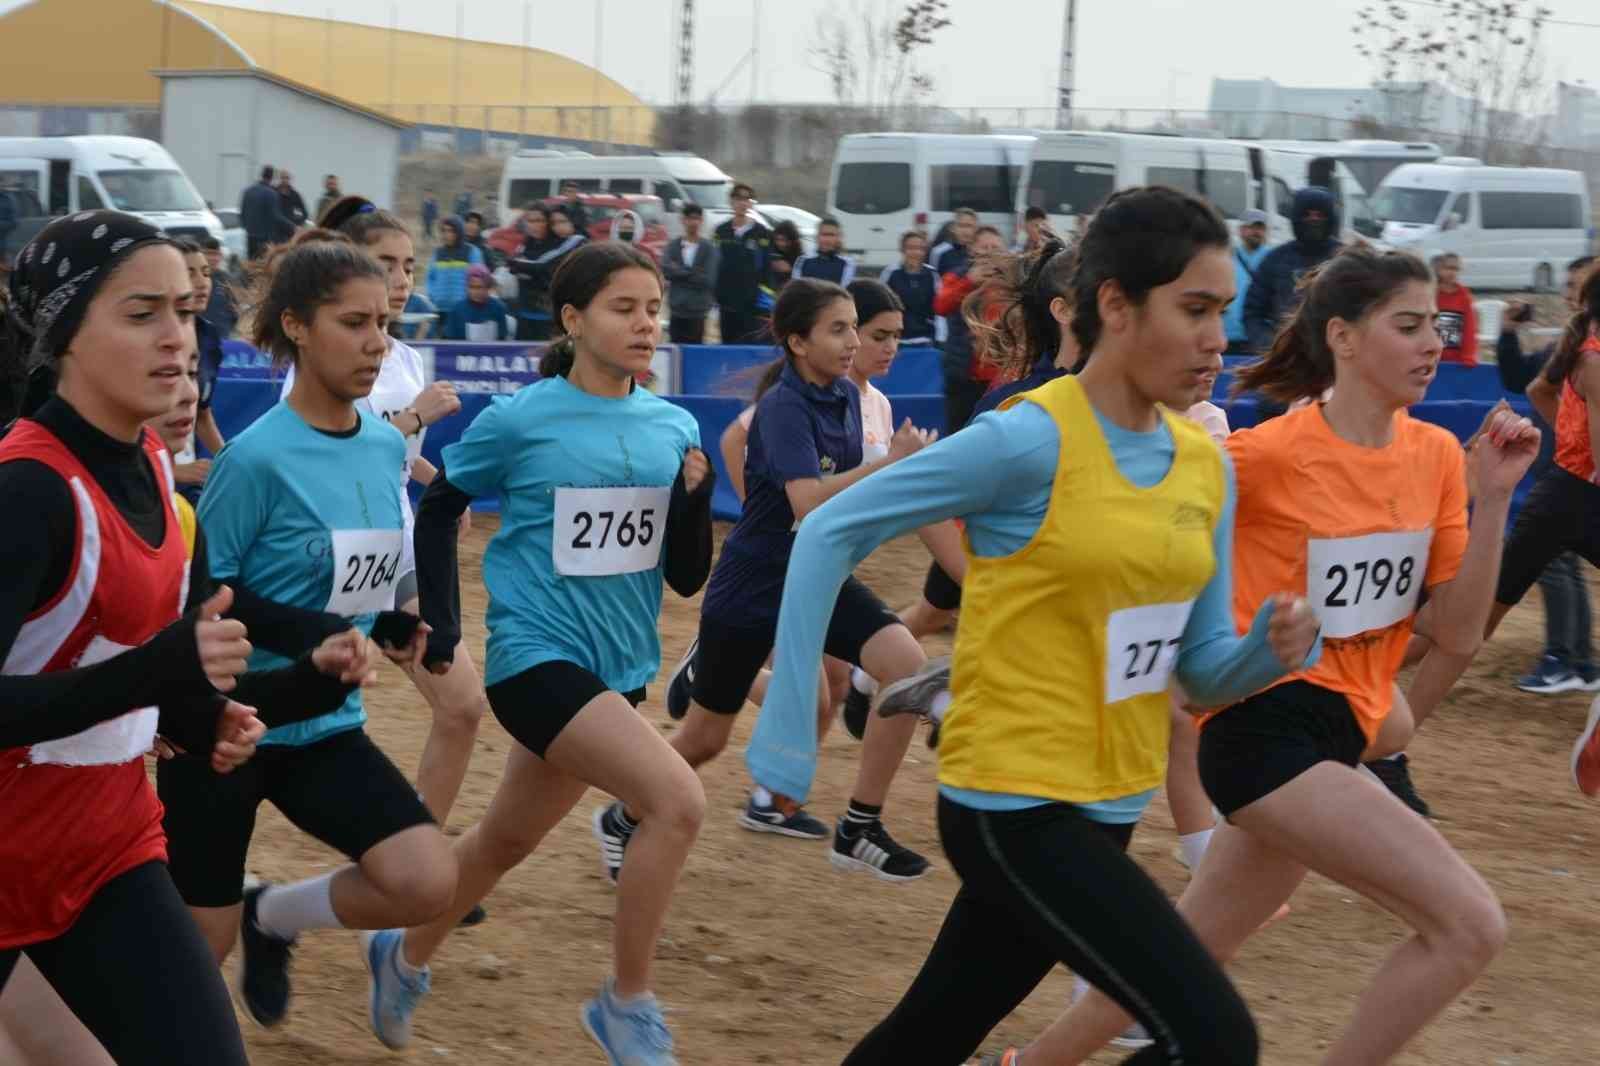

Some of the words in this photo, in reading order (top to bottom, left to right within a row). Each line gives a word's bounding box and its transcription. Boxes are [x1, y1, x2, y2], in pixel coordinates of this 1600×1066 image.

[572, 508, 655, 549] 2765
[341, 551, 401, 593] 2764
[1324, 555, 1416, 606] 2798
